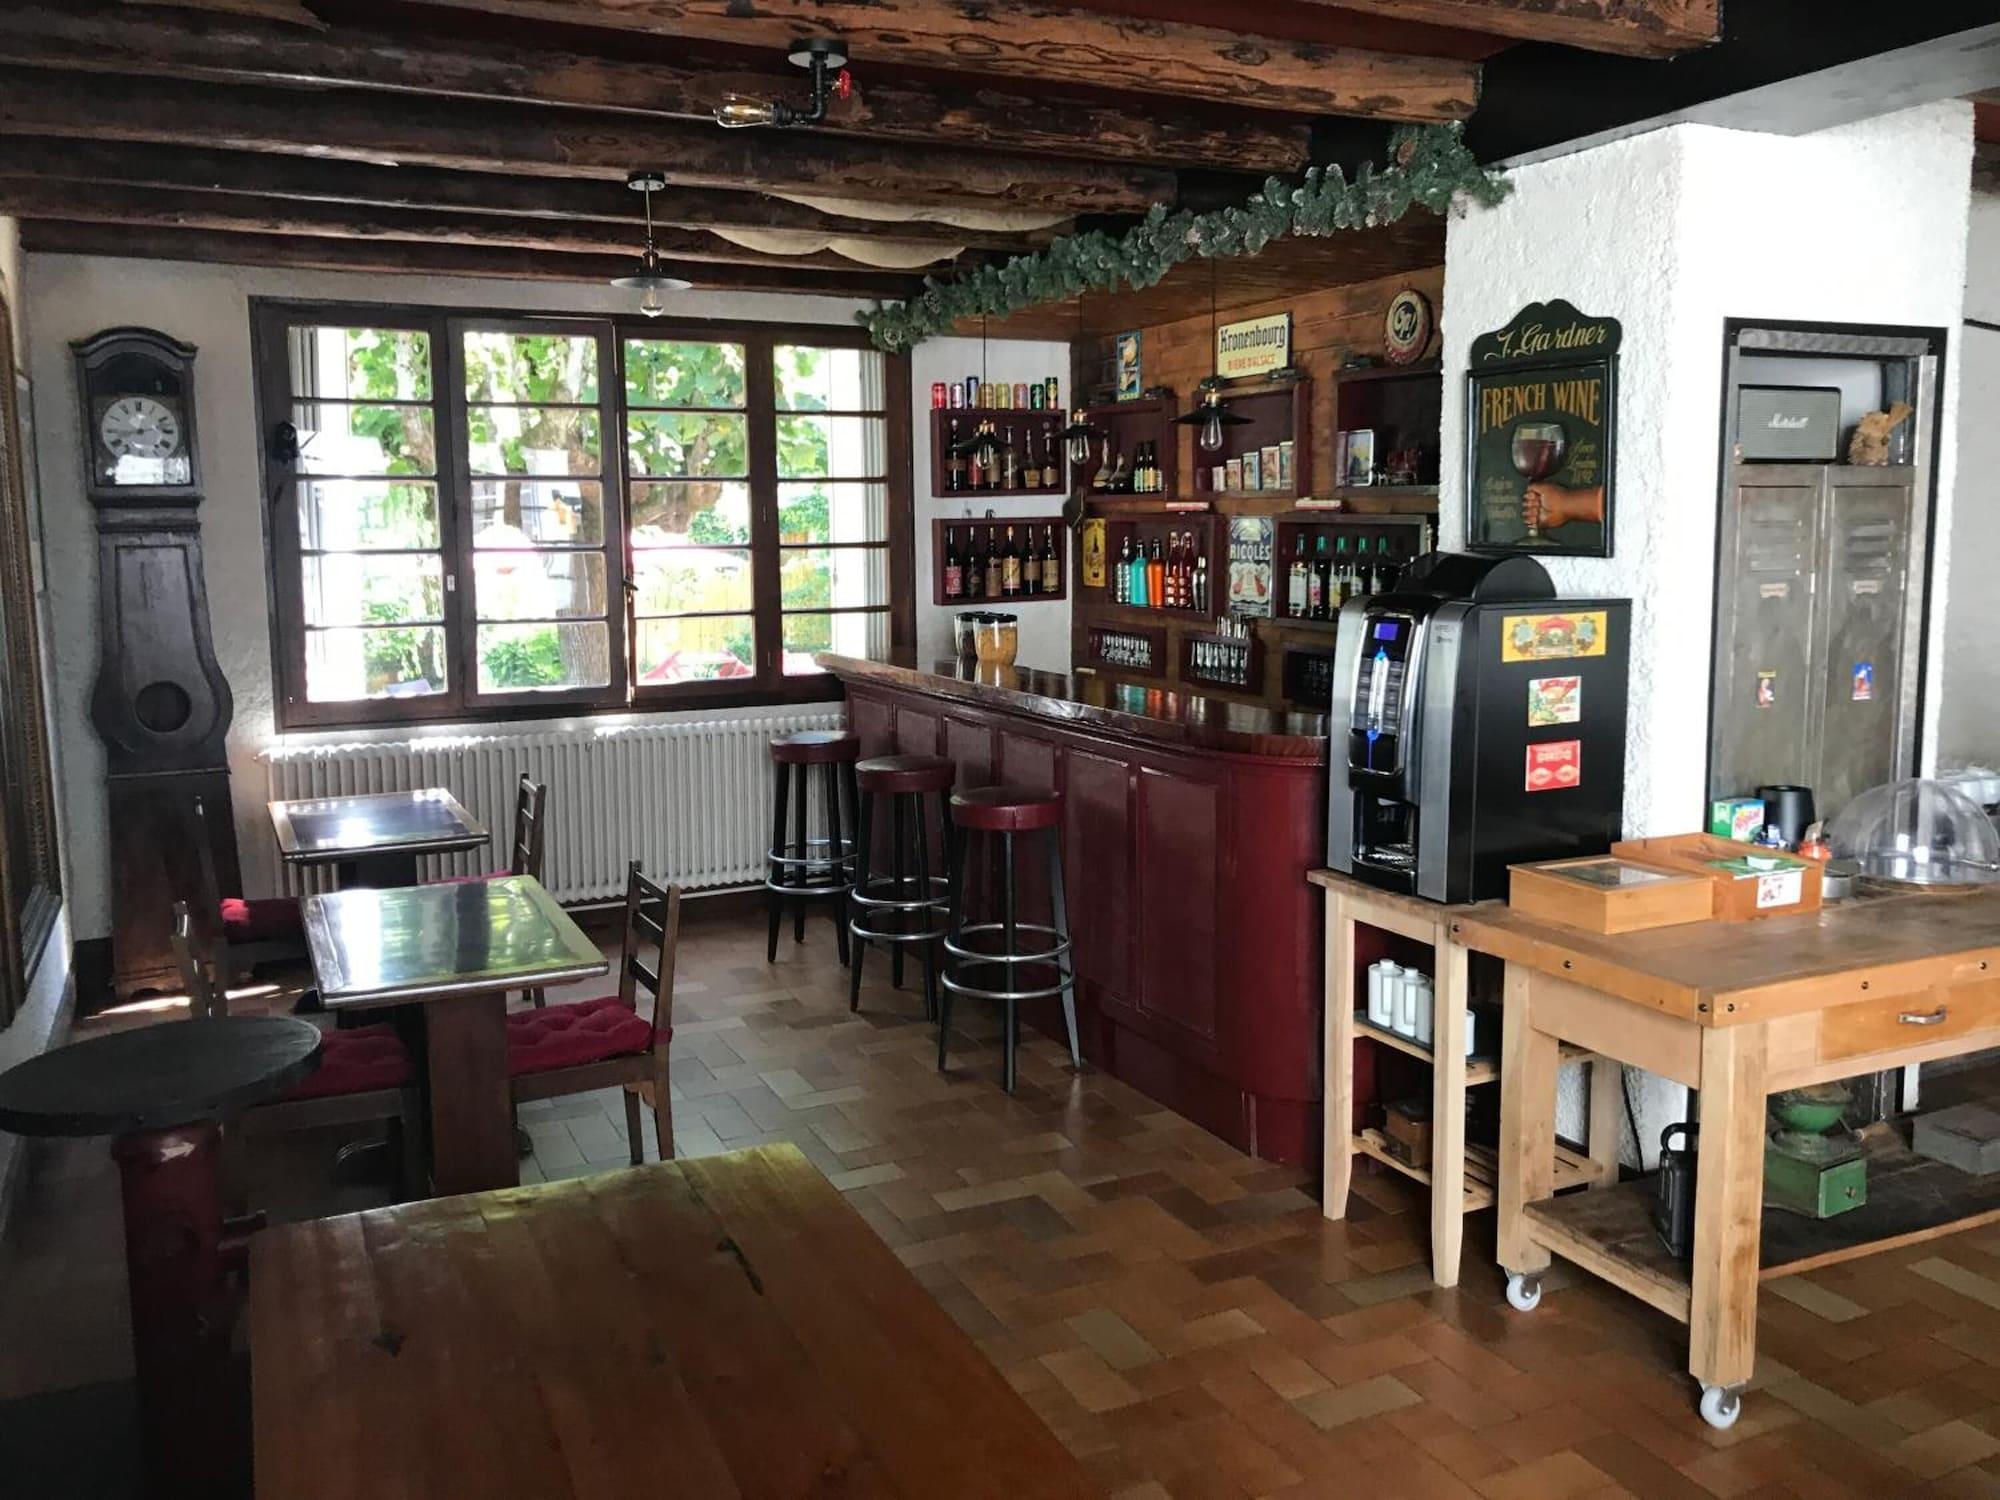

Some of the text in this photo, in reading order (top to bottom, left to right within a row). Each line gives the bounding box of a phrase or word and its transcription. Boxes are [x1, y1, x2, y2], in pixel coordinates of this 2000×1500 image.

[1220, 325, 1286, 354] Kronenbourg
[1513, 321, 1607, 357] Gardner
[1482, 379, 1601, 434] FRENCH WINE
